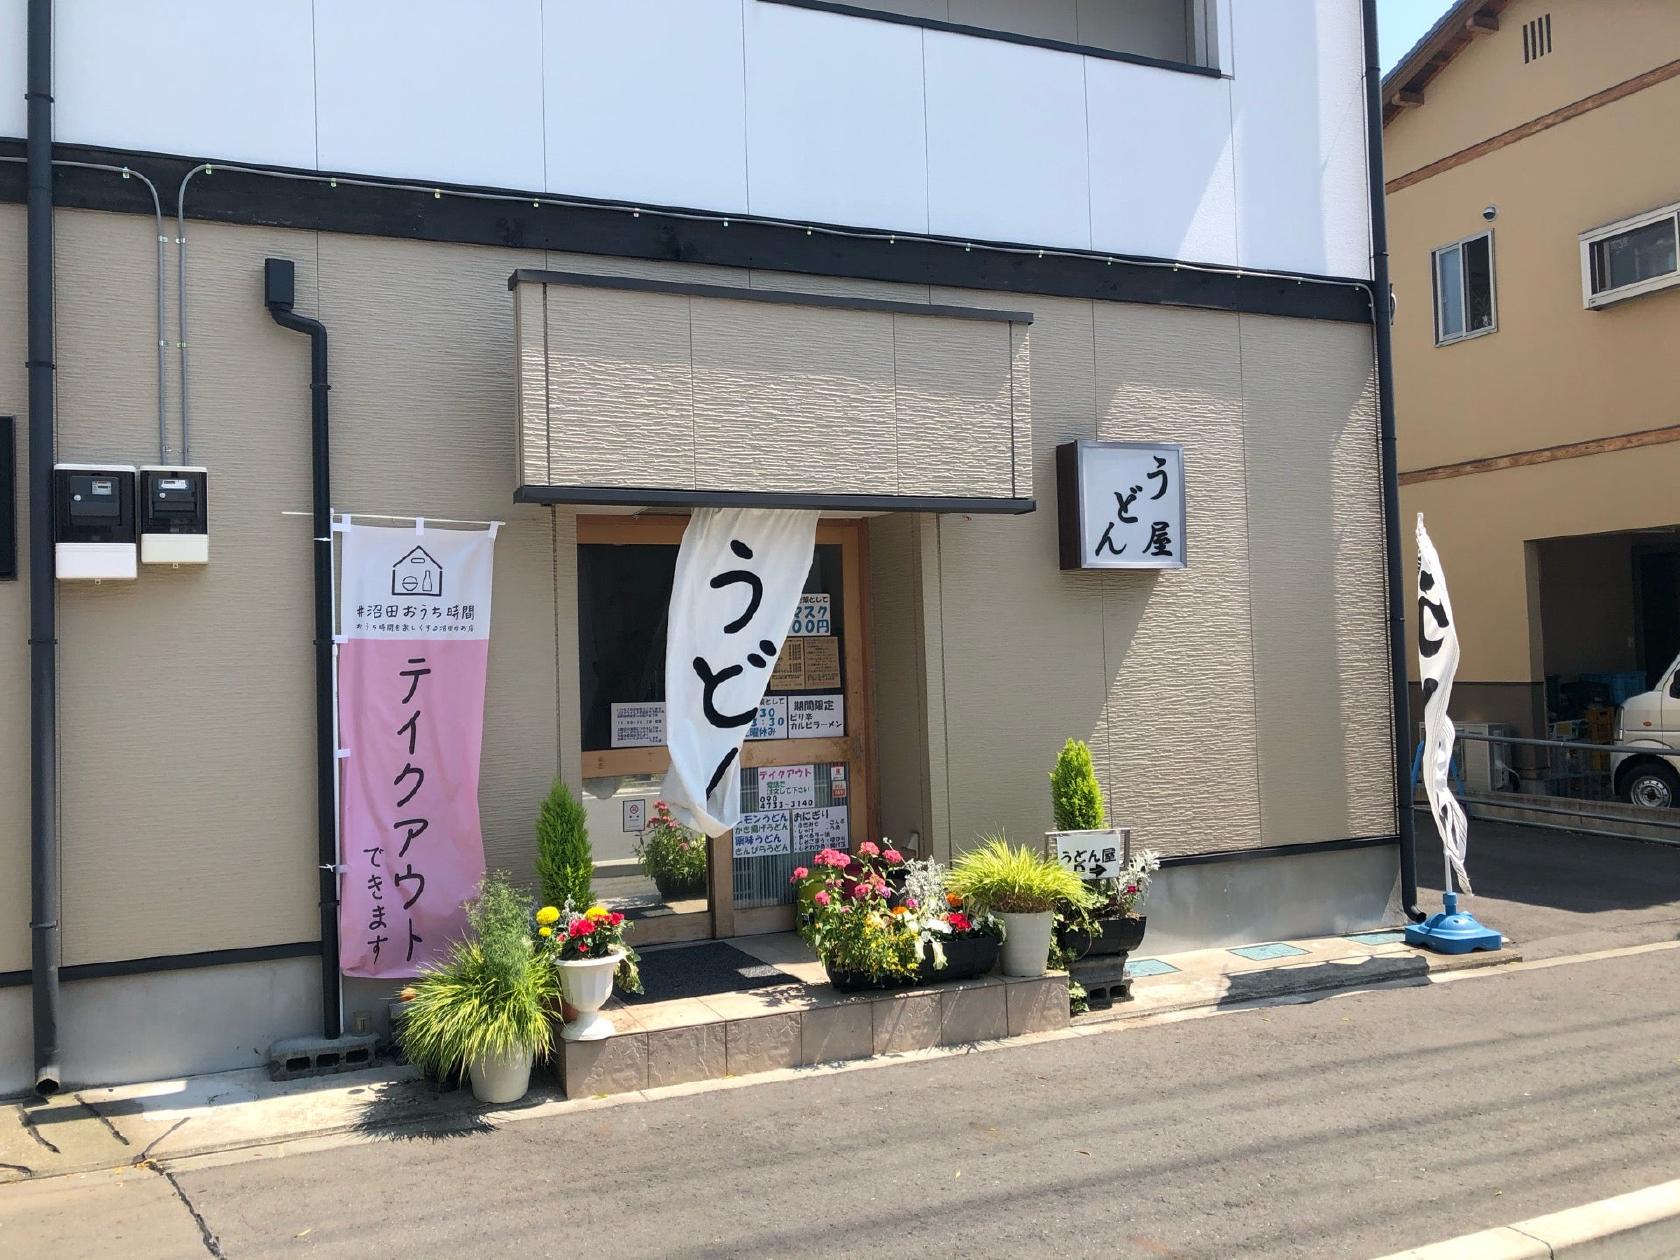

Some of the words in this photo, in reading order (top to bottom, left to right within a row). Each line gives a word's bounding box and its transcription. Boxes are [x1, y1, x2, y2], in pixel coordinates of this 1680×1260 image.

[356, 604, 475, 620] #沼田おうち時間
[794, 700, 834, 711] 期間限定
[759, 768, 811, 780] テイクアウト
[394, 658, 431, 962] テイクアウト
[794, 809, 829, 822] おにぎり
[1061, 848, 1116, 863] うどん屋
[363, 847, 388, 965] できます
